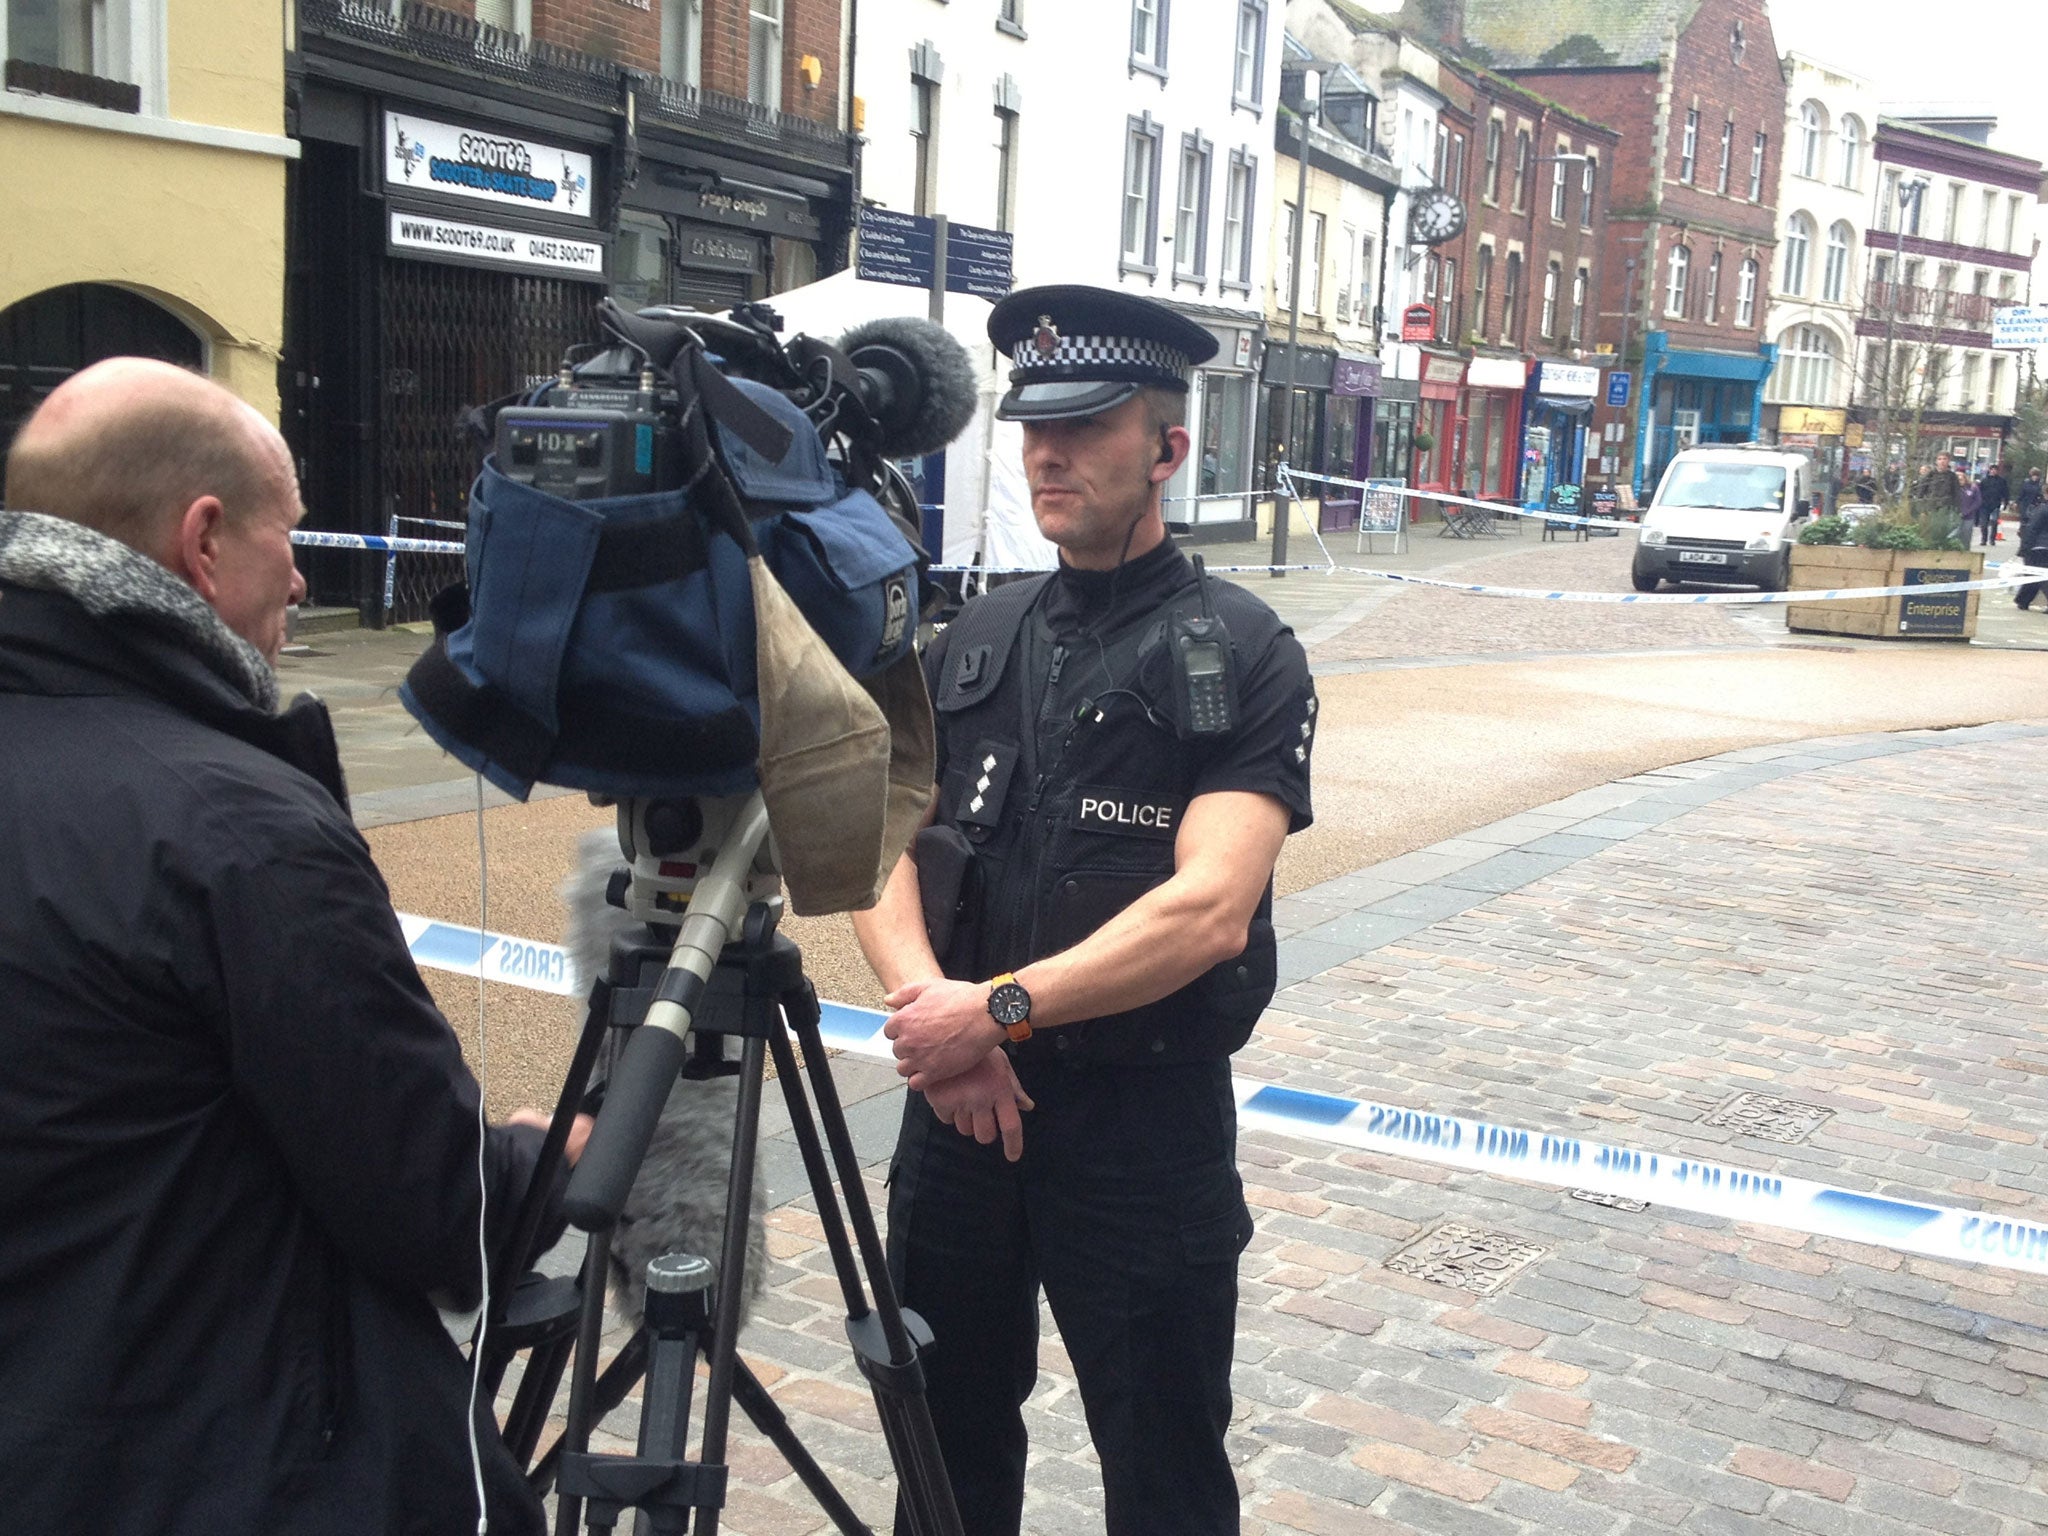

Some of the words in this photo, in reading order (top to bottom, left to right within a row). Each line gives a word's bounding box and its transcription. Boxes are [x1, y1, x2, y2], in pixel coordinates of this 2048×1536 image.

[459, 133, 525, 173] SCOOT69
[430, 155, 483, 190] SCOOTER
[492, 169, 527, 198] SKATE
[526, 176, 557, 203] SHOP
[529, 239, 557, 260] 01452
[558, 245, 595, 265] 300477
[1995, 316, 2048, 325] CLEANING
[2011, 308, 2031, 316] DRY
[1906, 601, 1961, 618] Enterprise
[1081, 798, 1172, 828] POLICE
